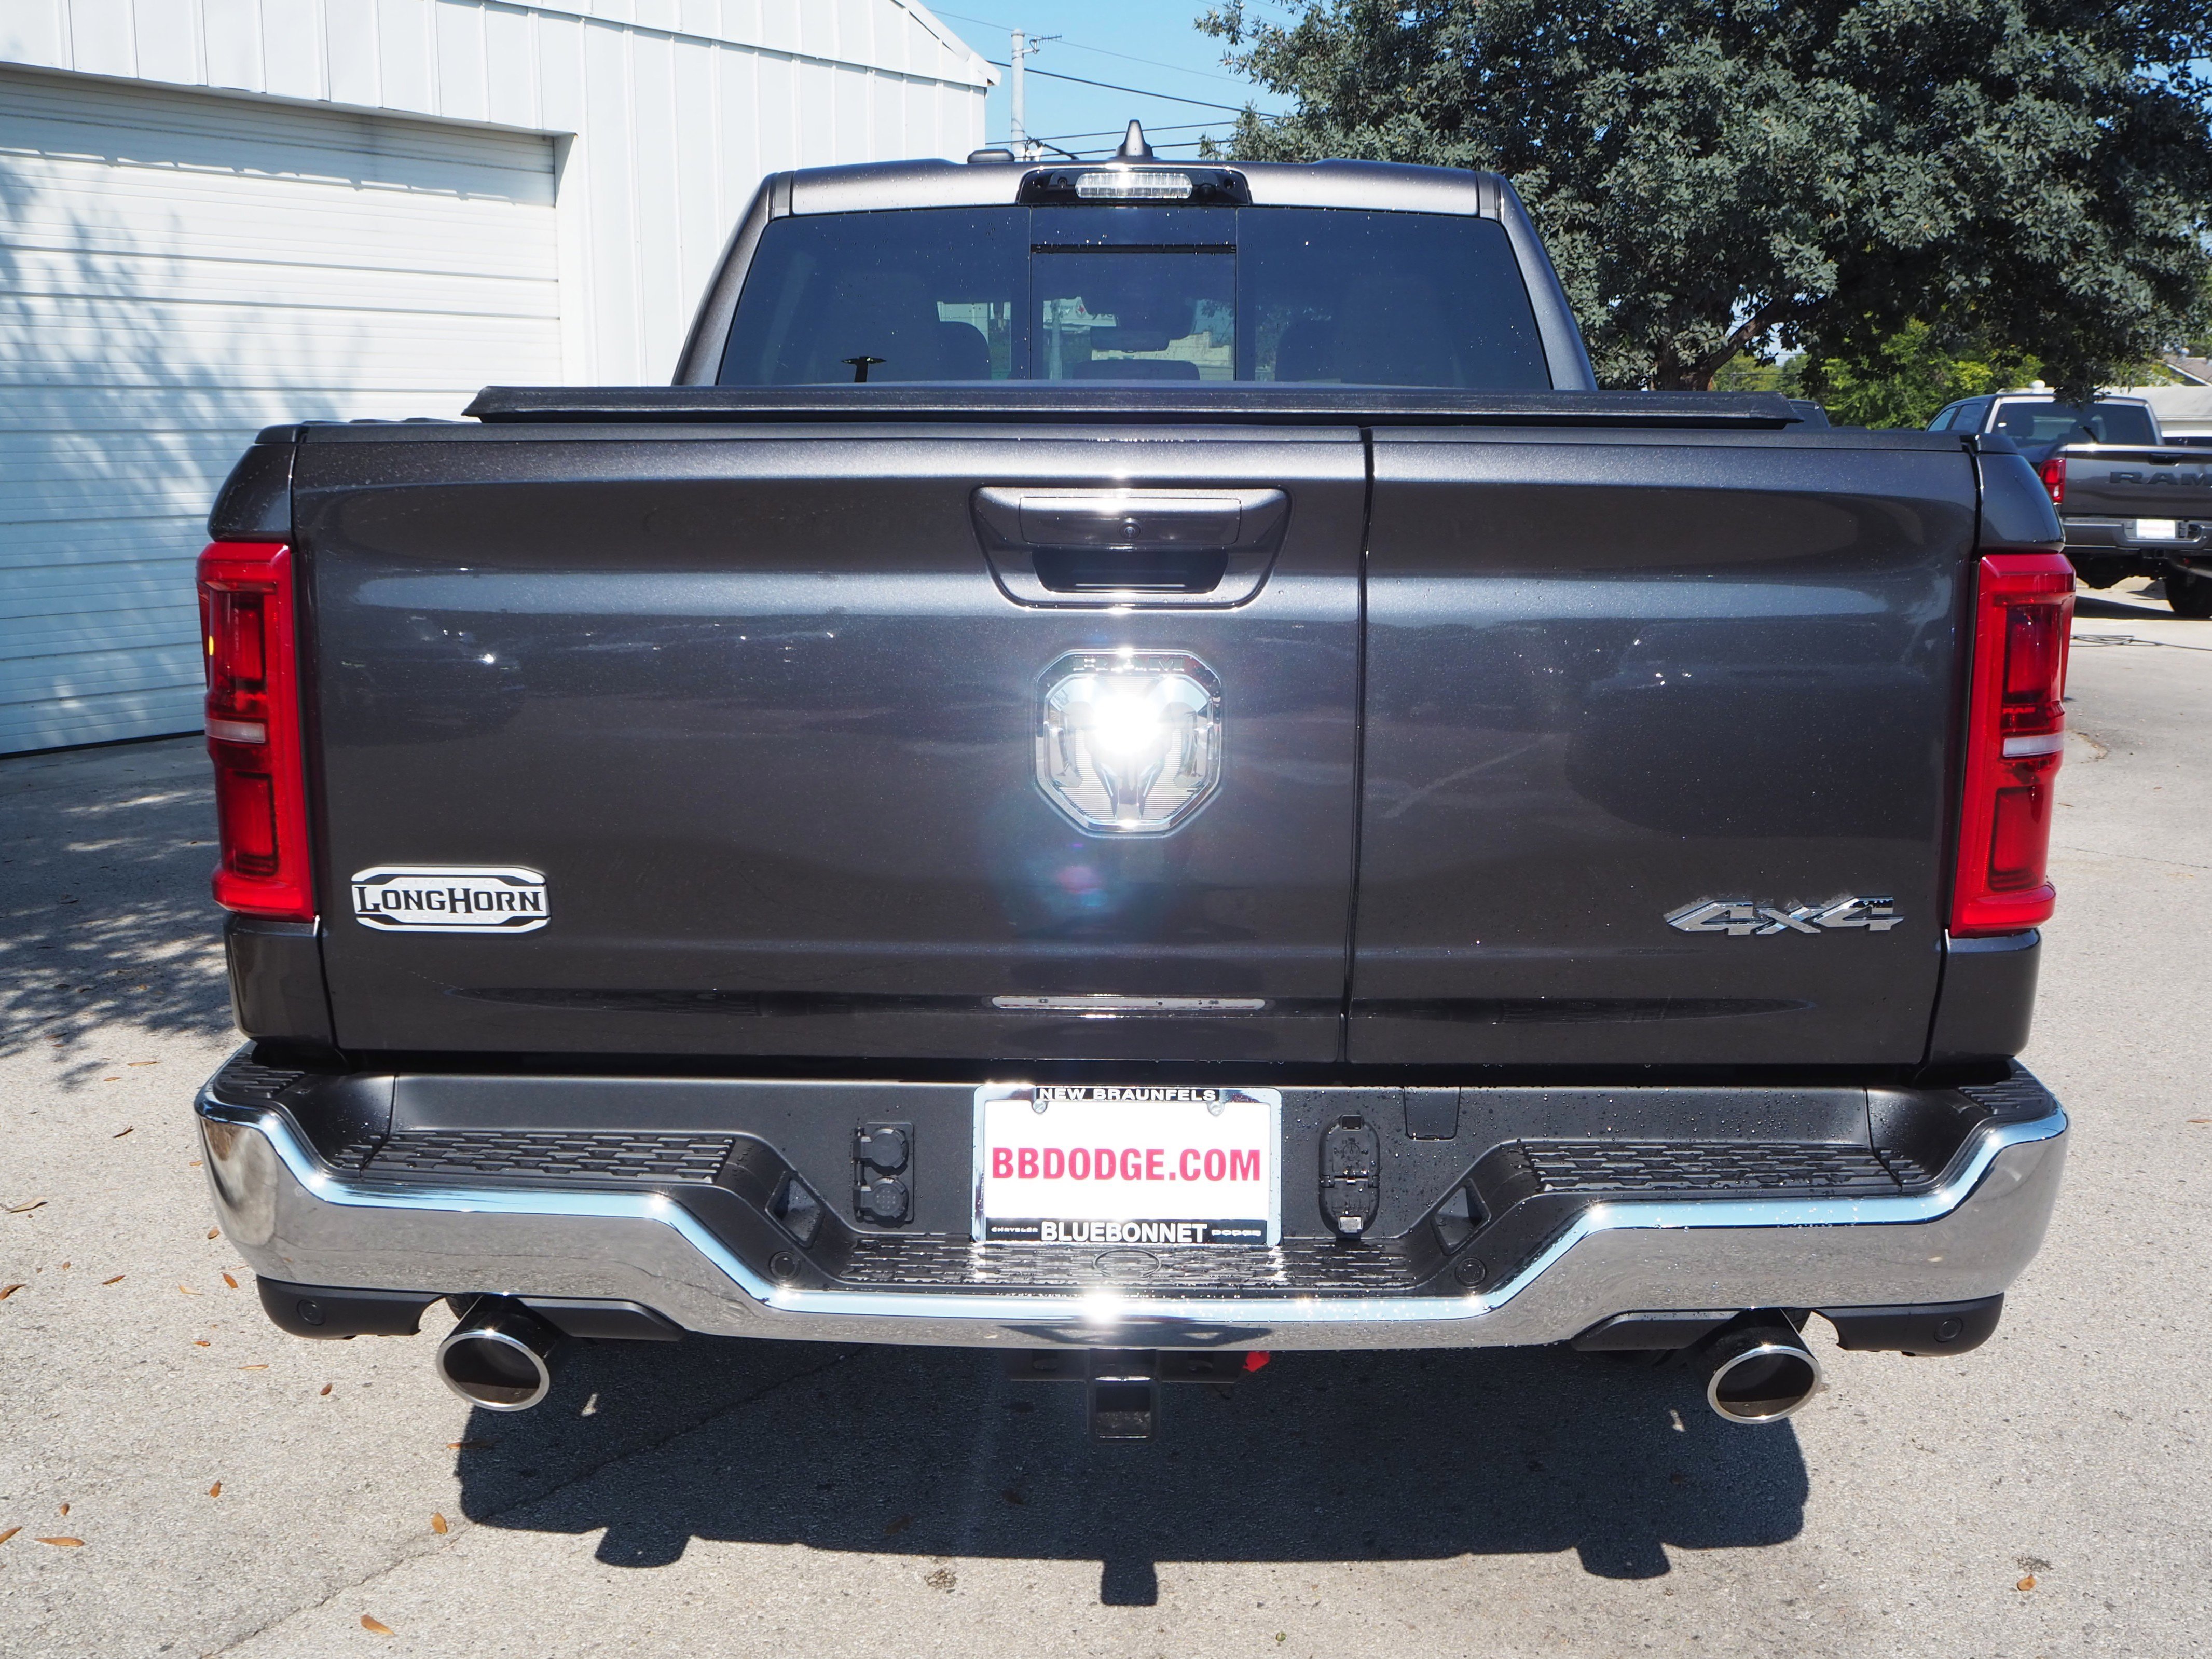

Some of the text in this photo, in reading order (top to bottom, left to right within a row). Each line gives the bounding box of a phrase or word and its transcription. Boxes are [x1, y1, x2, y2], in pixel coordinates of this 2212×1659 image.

[2110, 471, 2212, 485] RAM
[1073, 656, 1184, 671] RAM
[1039, 1088, 1216, 1101] NEW BRAUNFELS
[992, 1147, 1261, 1181] BBDODGE.COM
[1041, 1221, 1208, 1243] BLUEBONNET
